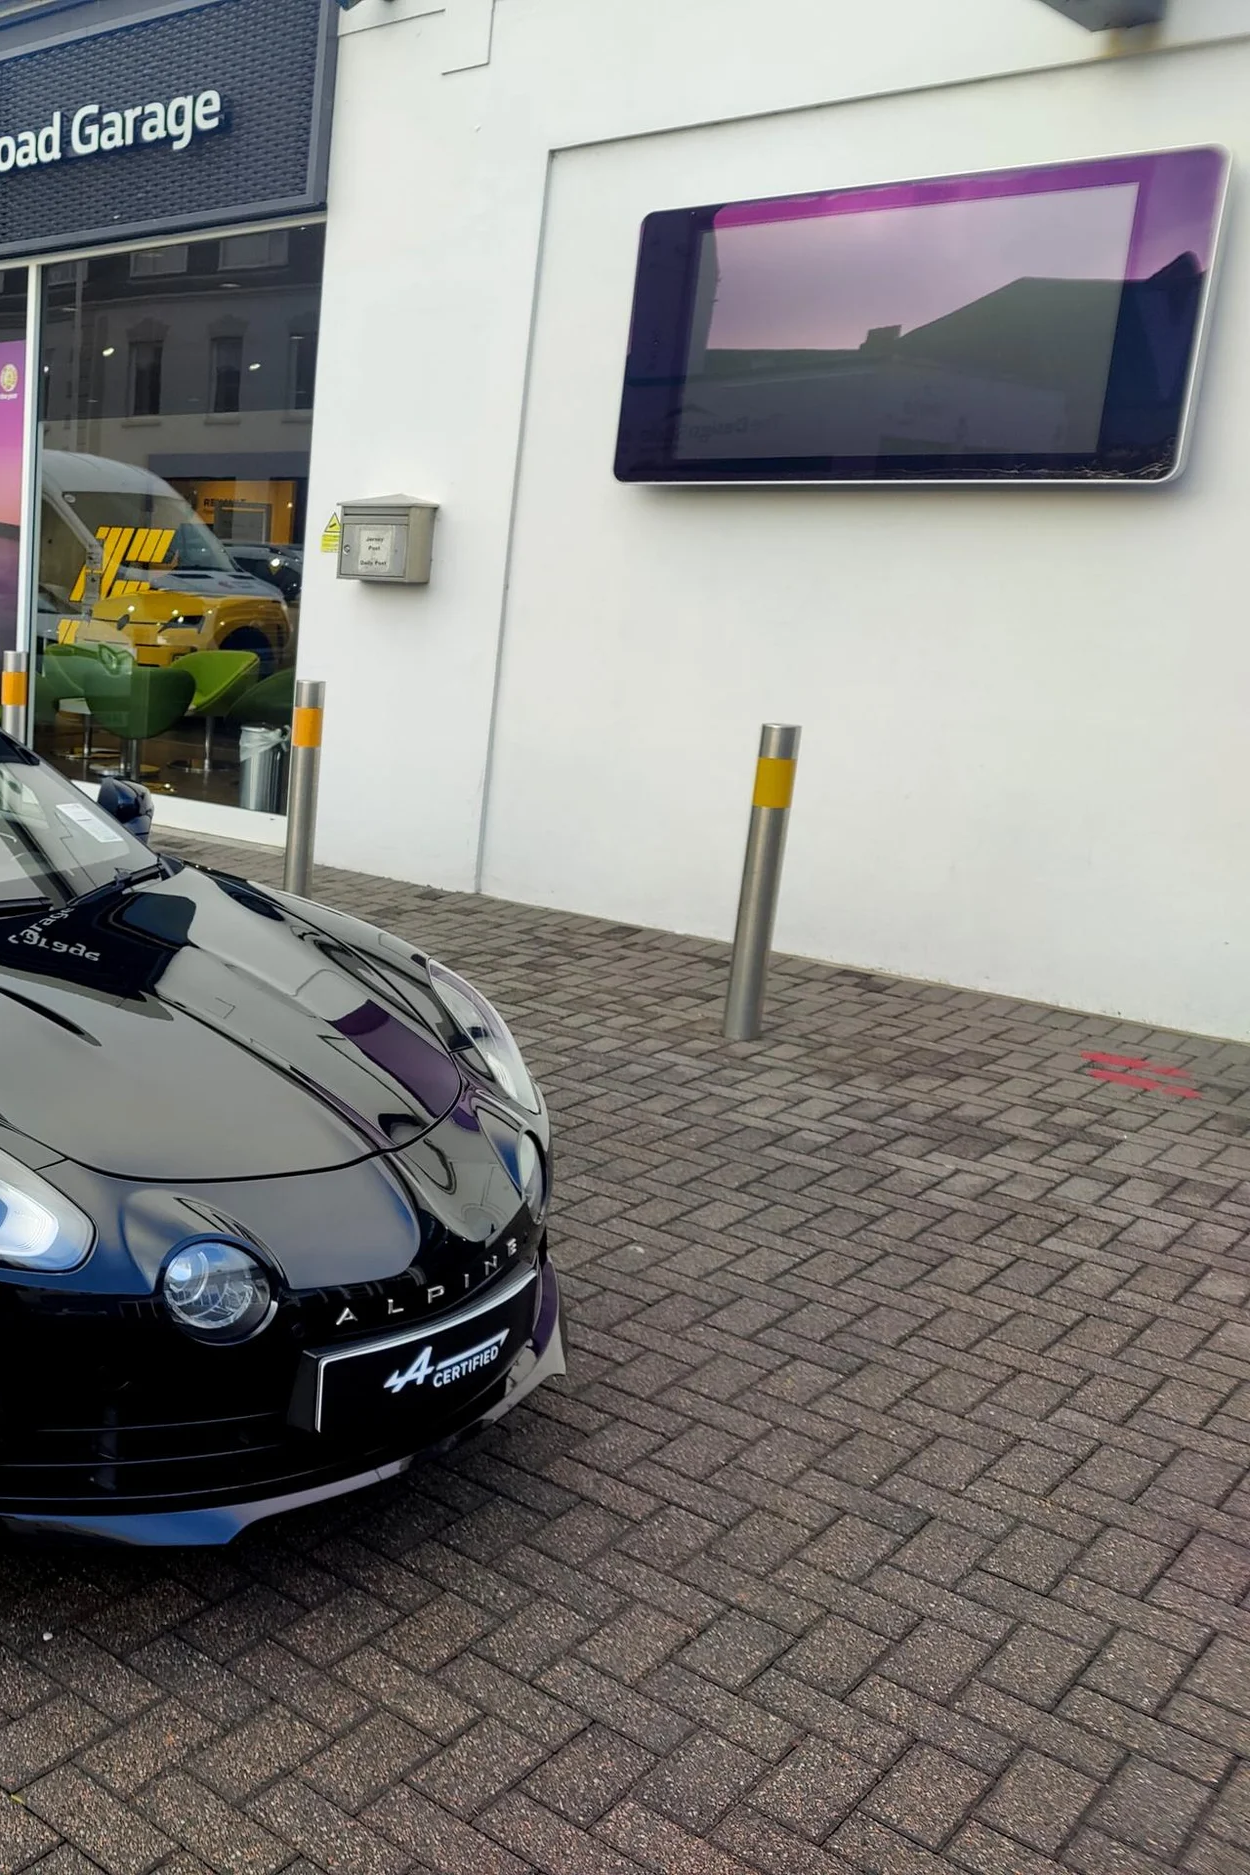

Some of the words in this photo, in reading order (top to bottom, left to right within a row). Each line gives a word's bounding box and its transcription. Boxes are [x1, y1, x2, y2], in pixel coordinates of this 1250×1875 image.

[71, 89, 221, 150] Garage
[335, 1238, 517, 1325] ALPINE
[433, 1346, 499, 1388] CERTIFIED
